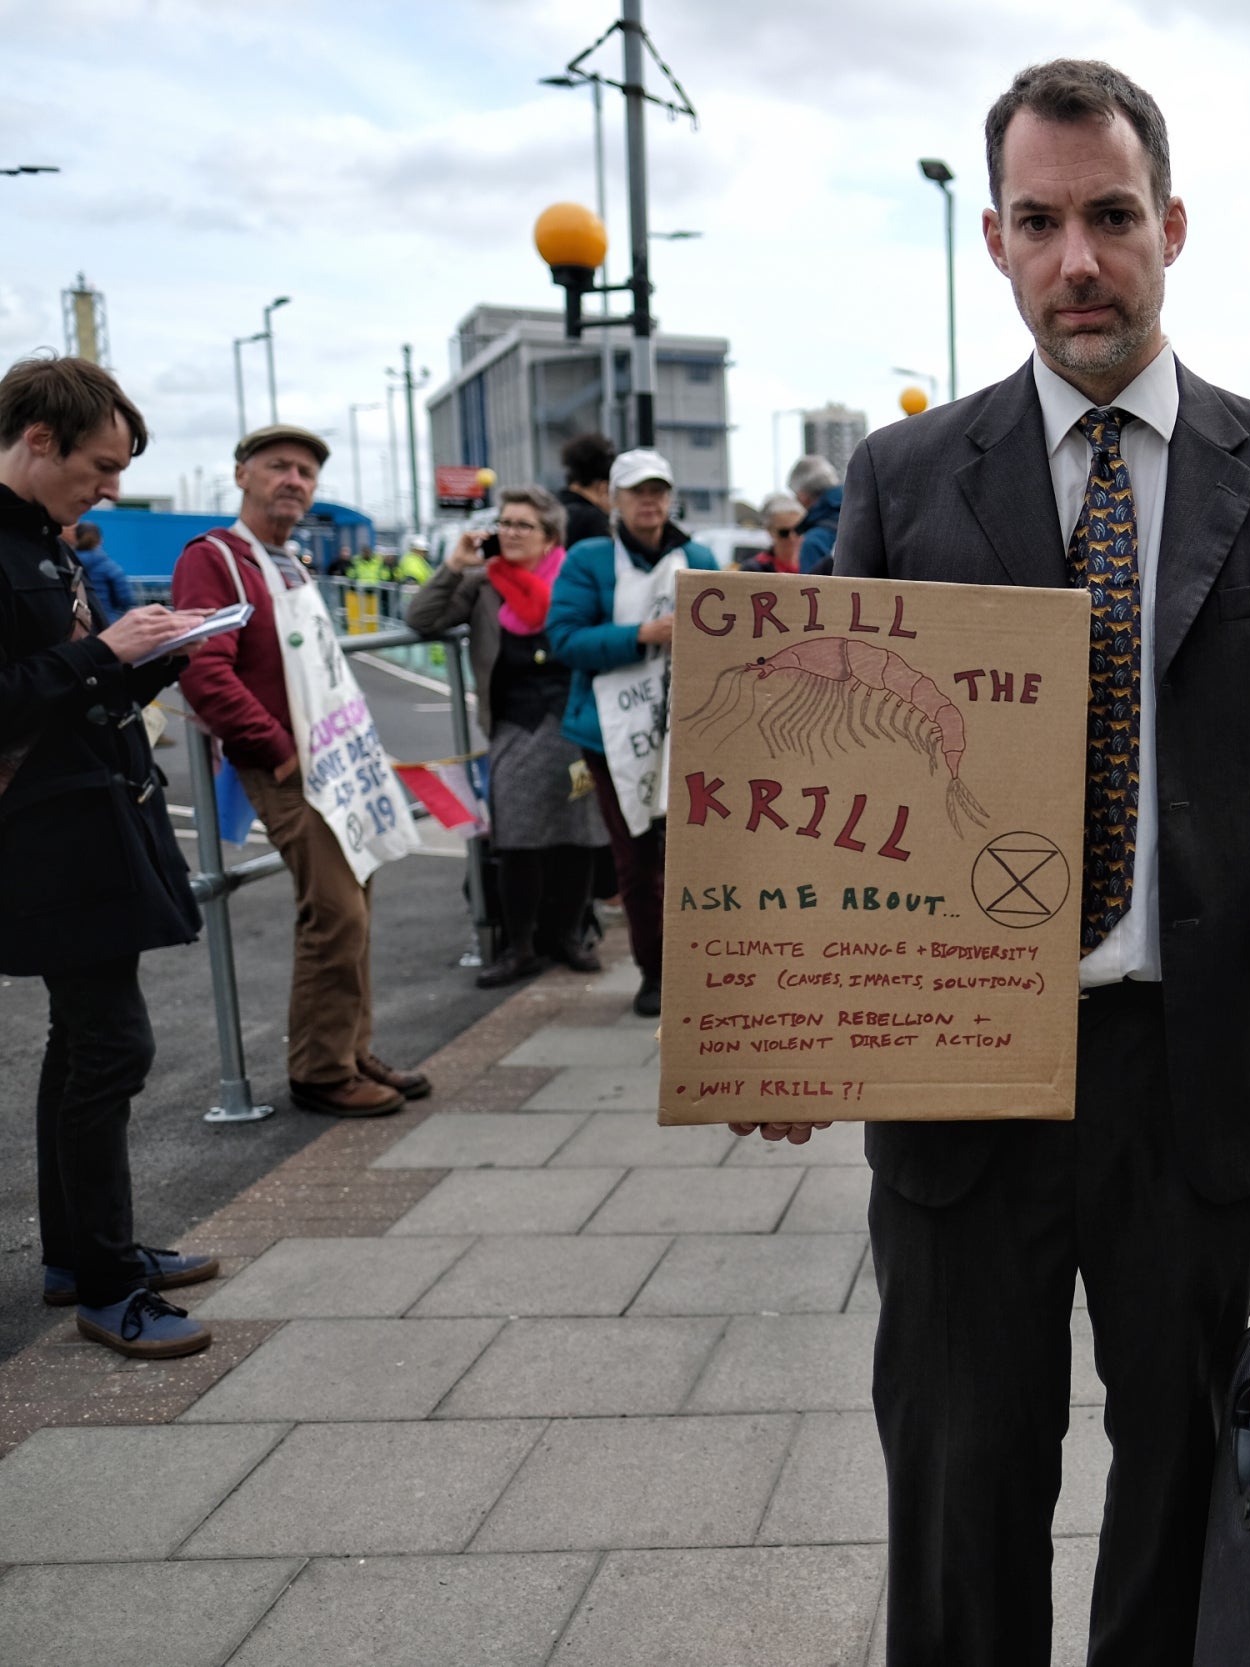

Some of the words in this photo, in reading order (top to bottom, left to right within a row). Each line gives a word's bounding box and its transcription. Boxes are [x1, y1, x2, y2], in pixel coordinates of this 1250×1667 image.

[691, 588, 917, 639] GRILL
[618, 678, 657, 711] ONE
[954, 668, 1042, 704] THE
[307, 750, 346, 793] HAVE
[685, 771, 911, 861] KRILL
[681, 884, 741, 911] ASK
[759, 884, 817, 910] ME
[705, 939, 804, 957] CLIMATE
[822, 941, 907, 958] CHANGE
[930, 942, 1038, 961] BIODIVERSITY
[706, 972, 756, 988] LOSS
[777, 969, 843, 989] (CAUSES,
[849, 973, 923, 989] IMPACTS,
[933, 972, 1045, 995] SOLUTIONS)
[699, 1013, 823, 1031] EXTINCTION
[838, 1011, 954, 1026] REBELLION
[699, 1039, 740, 1056] NON
[750, 1036, 833, 1053] VIOLENT
[849, 1033, 919, 1048] DIRECT
[935, 1033, 1012, 1048] ACTION
[700, 1079, 745, 1096] WHY
